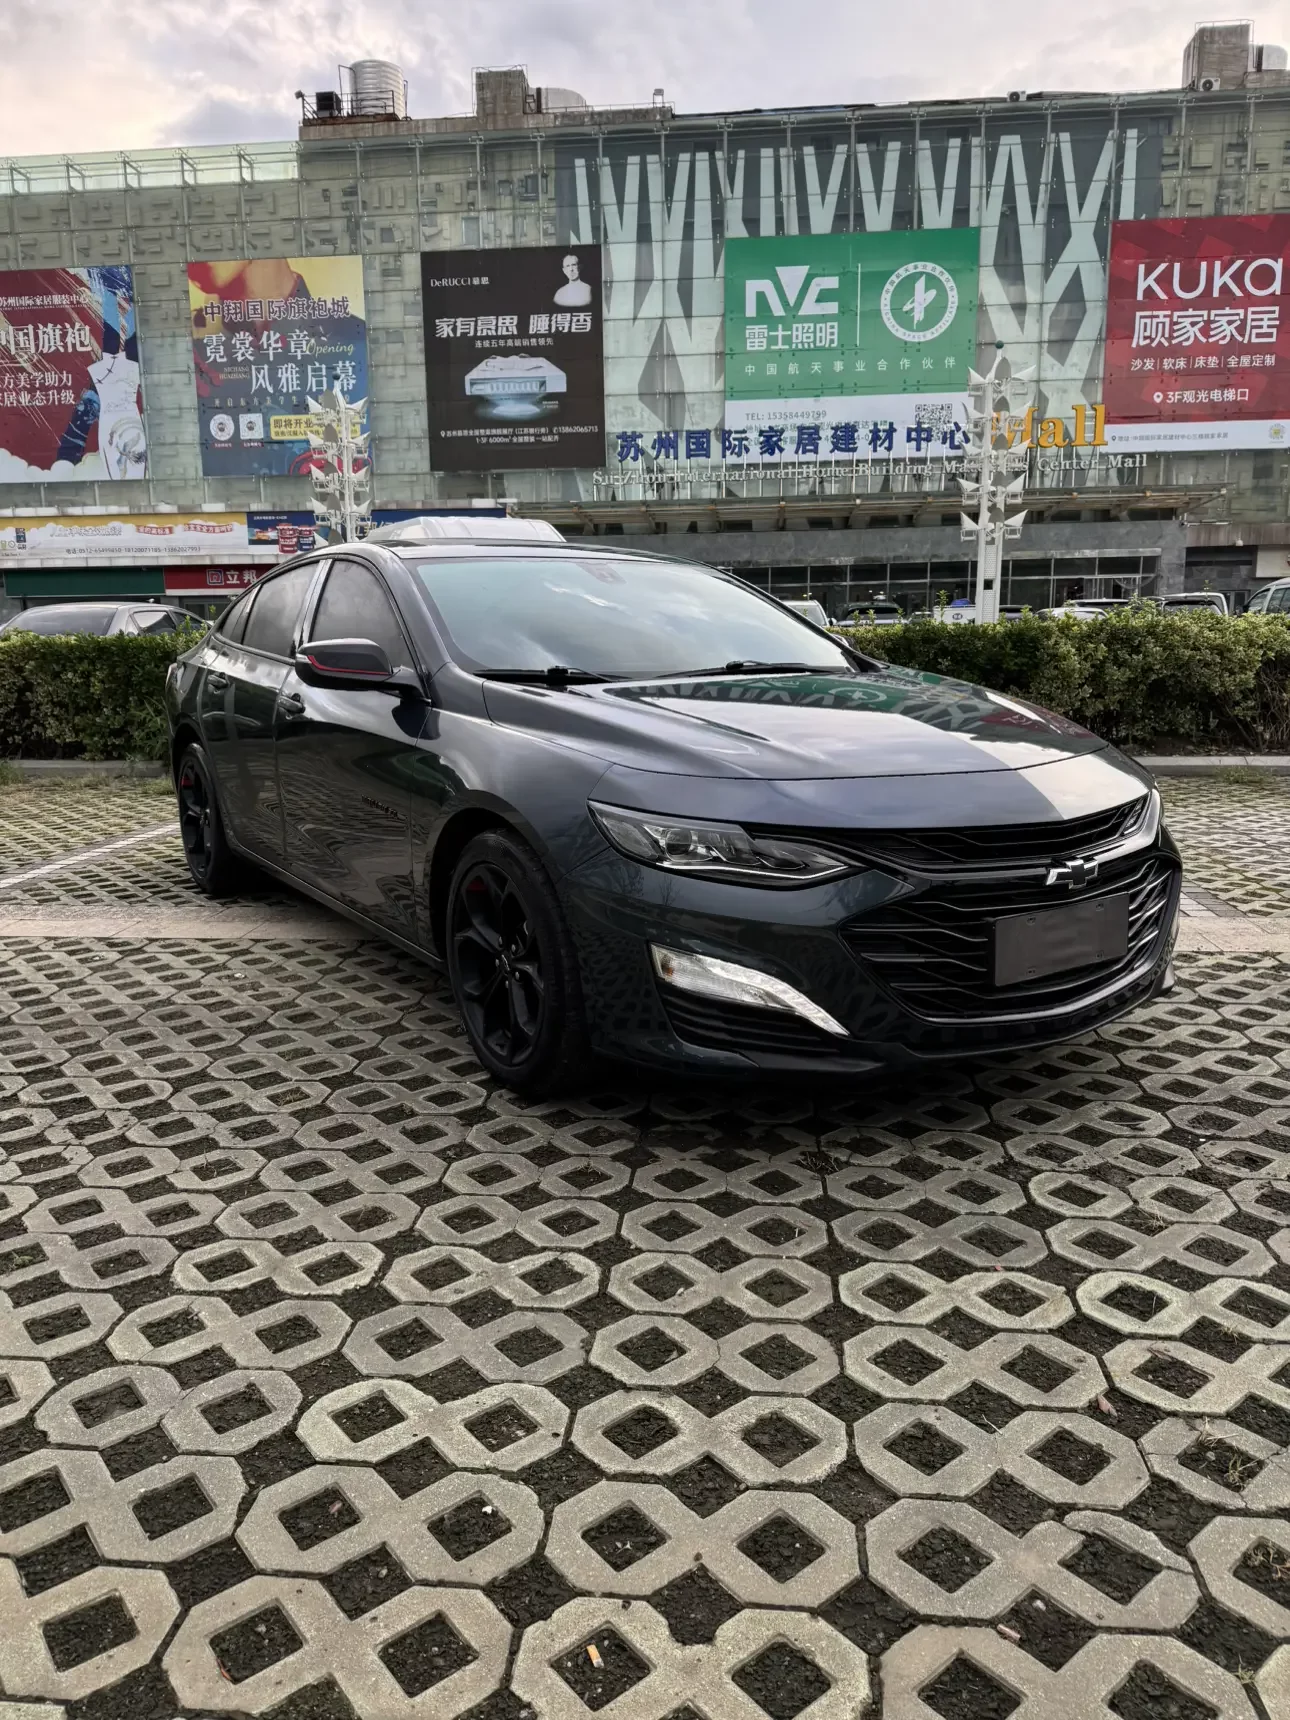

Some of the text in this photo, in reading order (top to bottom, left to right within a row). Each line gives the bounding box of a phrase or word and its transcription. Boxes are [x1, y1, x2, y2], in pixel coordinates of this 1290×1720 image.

[430, 278, 471, 287] DeRUCCI
[204, 296, 350, 322] 中翔国际旗袍城
[435, 313, 592, 338] 家有慕思 睡得香
[745, 322, 839, 350] 雷士照明
[1131, 306, 1280, 347] 顾家家居
[0, 322, 92, 355] 国旗袍
[203, 329, 311, 363] 霓裳华章
[306, 339, 354, 358] Opening
[745, 356, 956, 376] 中国航天事业合作伙伴
[0, 371, 72, 388] 方美学助力
[1166, 389, 1249, 404] 3F观光电梯口
[616, 421, 971, 462] 苏州国际家居建材中心
[1038, 456, 1099, 472] Center
[1108, 454, 1148, 469] Mall
[225, 569, 257, 584] 立邦
